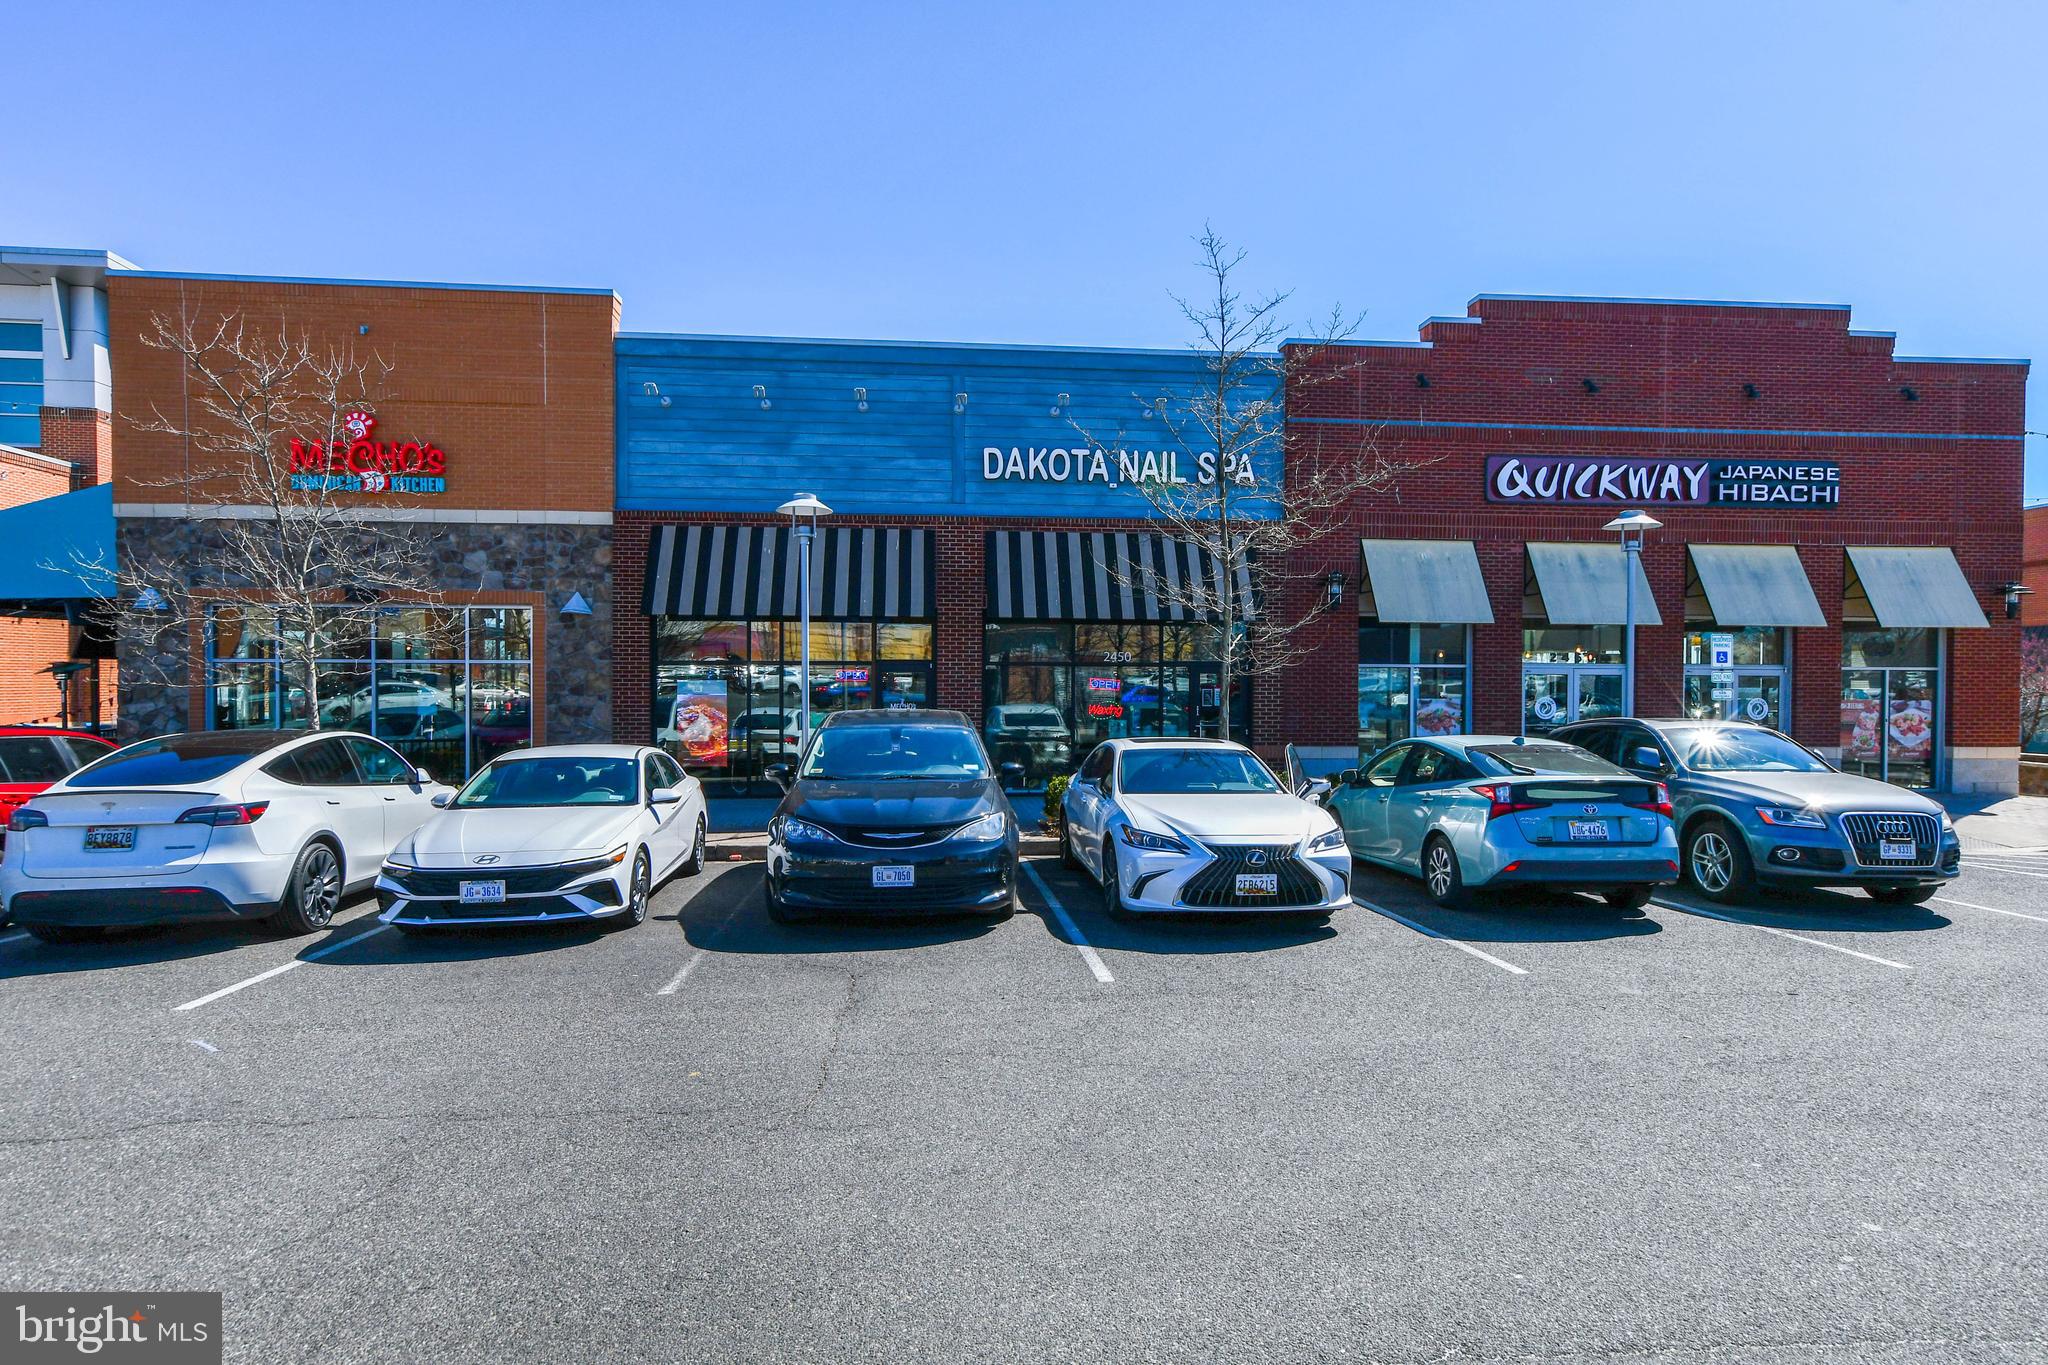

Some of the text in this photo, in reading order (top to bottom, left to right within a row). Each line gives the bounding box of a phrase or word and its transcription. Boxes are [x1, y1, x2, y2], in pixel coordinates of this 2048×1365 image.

[983, 447, 1255, 485] DAKOTA NAIL SPA
[391, 476, 446, 493] KITCHEN
[1497, 458, 1840, 500] QUICKWAY JAPANESE
[1719, 483, 1840, 503] HIBACHI
[1103, 651, 1132, 662] 2450
[838, 671, 867, 680] OPEN
[1092, 680, 1119, 689] OPEN
[1088, 704, 1124, 718] Waxing
[1883, 845, 1892, 854] GP
[876, 871, 911, 881] GL 7050
[464, 886, 501, 898] JG 3634
